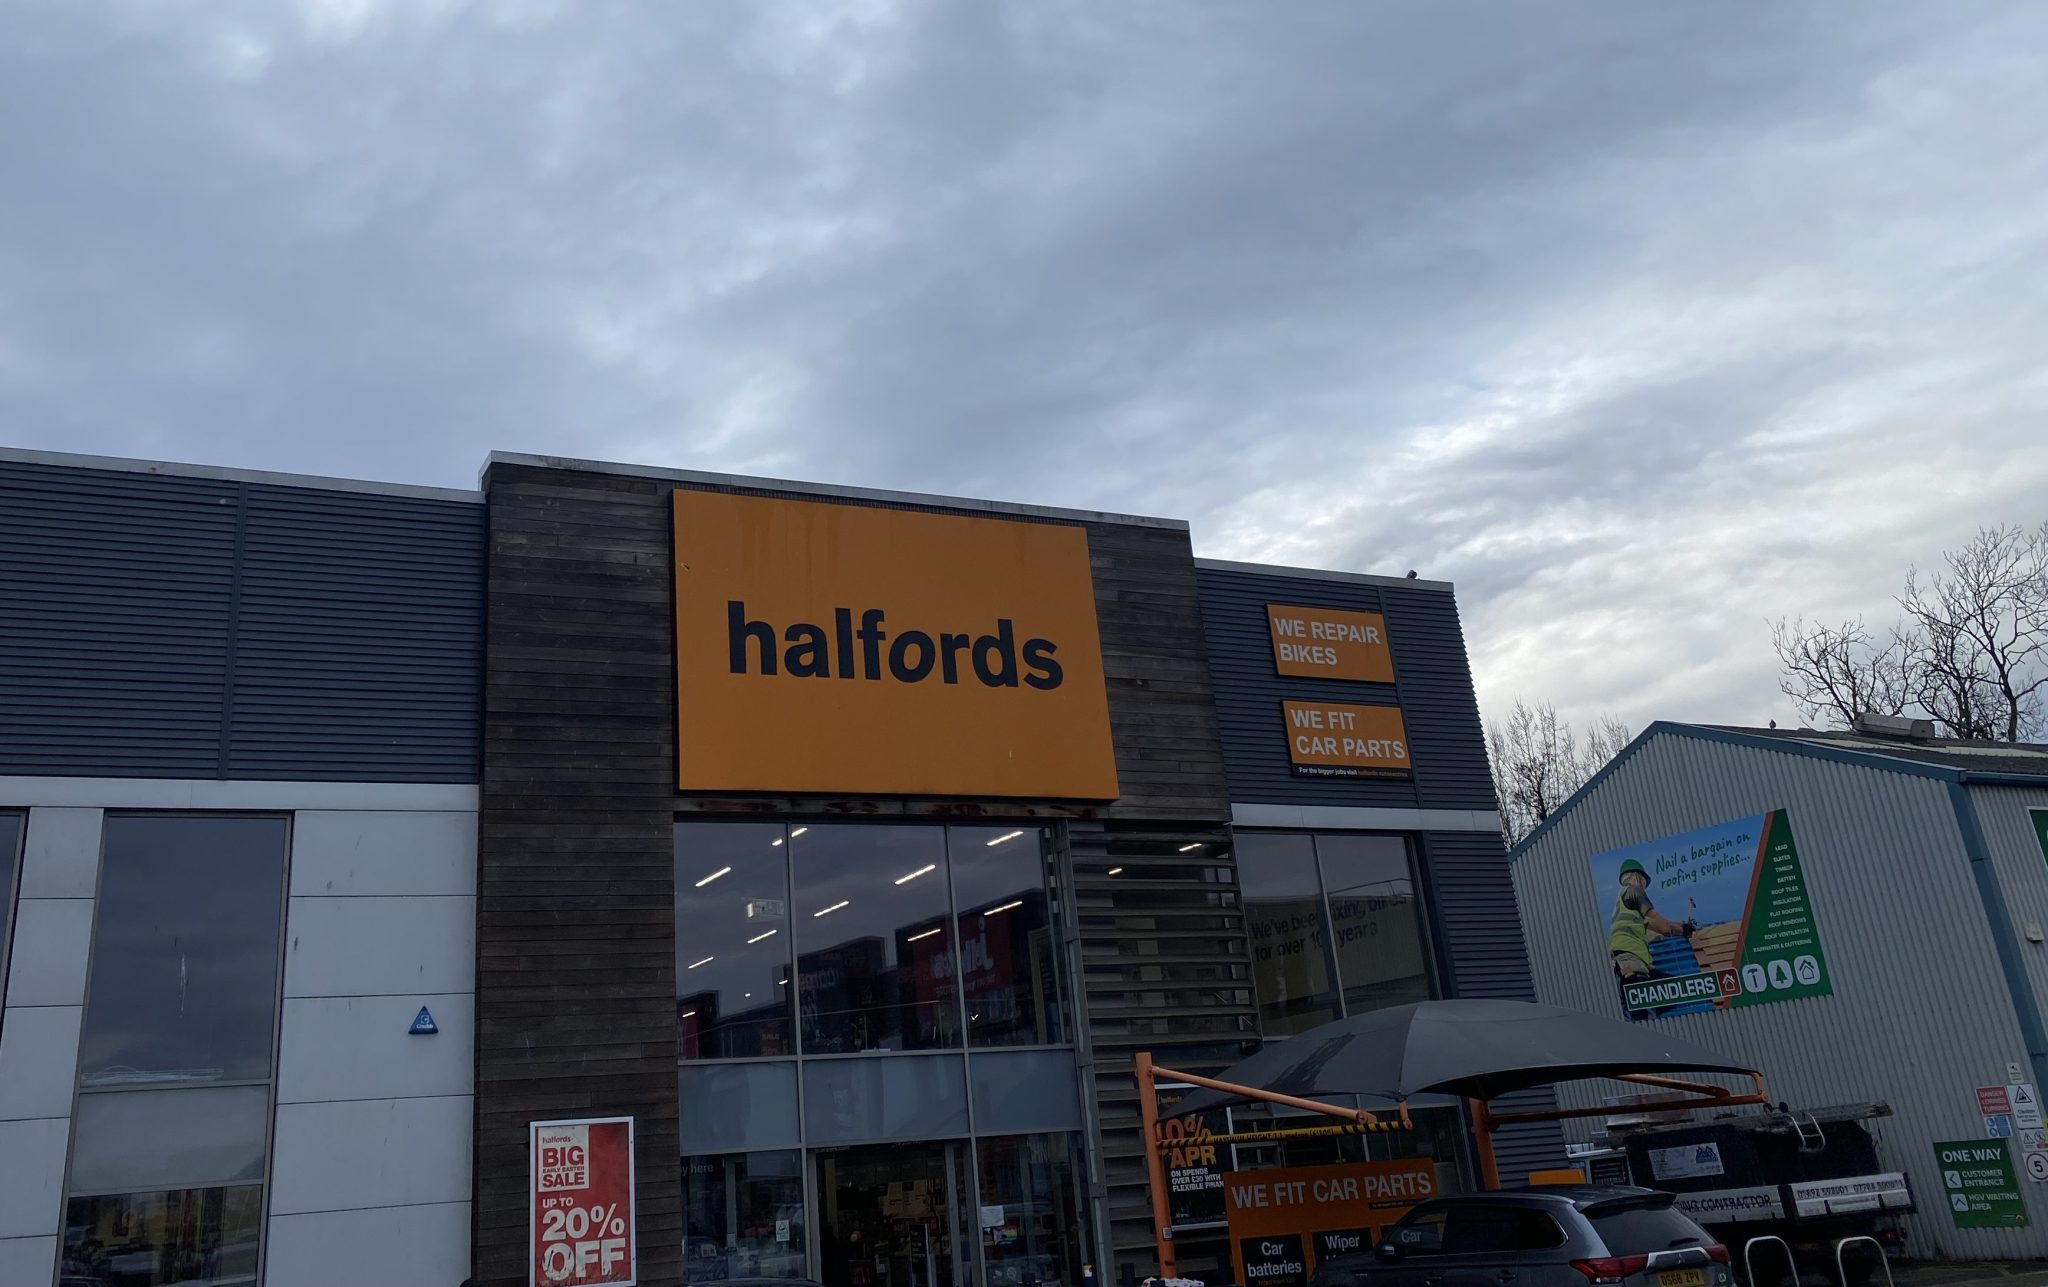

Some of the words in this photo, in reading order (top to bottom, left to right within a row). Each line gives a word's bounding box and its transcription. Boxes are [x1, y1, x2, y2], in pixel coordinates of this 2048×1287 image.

[1274, 617, 1307, 638] WE
[1311, 621, 1381, 644] REPAIR
[728, 600, 1063, 690] halfords
[1279, 643, 1338, 666] BIKES
[1291, 709, 1324, 728] WE
[1328, 711, 1356, 731] FIT
[1296, 735, 1339, 756] CAR
[1342, 738, 1406, 759] PARTS
[1318, 768, 1334, 776] bigger
[1656, 852, 1678, 875] Nail
[1681, 855, 1688, 864] a
[1691, 838, 1733, 859] bargain
[1736, 832, 1751, 843] on
[1660, 869, 1697, 889] roofing
[1627, 977, 1716, 1006] CHANDLERS
[542, 1135, 571, 1144] halfords
[542, 1145, 584, 1168] BIG
[1170, 1145, 1217, 1169] APR
[1942, 1149, 1971, 1163] ONE
[1971, 1148, 2001, 1161] WAY
[1171, 1169, 1181, 1178] ON
[1182, 1167, 1209, 1177] SPENDS
[1962, 1169, 2003, 1178] CUSTOMER
[2034, 1160, 2044, 1173] 5
[542, 1172, 585, 1188] SALE
[1172, 1176, 1190, 1185] OVER
[1204, 1173, 1221, 1182] WITH
[1172, 1182, 1204, 1193] FLEXIBLE
[1204, 1180, 1224, 1189] FINAN
[1963, 1178, 2005, 1187] ENTRANCE
[1231, 1184, 1269, 1209] WE
[1274, 1181, 1306, 1206] FIT
[1312, 1177, 1359, 1204] CAR
[1365, 1172, 1432, 1200] PARTS
[1968, 1193, 1985, 1201] HGV
[1985, 1192, 2019, 1201] WAITING
[542, 1199, 557, 1208] UP
[559, 1197, 574, 1206] TO
[1701, 1194, 1772, 1212] CONTRACTOR
[1971, 1202, 1992, 1211] AREA
[542, 1203, 625, 1242] 20%
[1324, 1233, 1360, 1252] Wiper
[1400, 1229, 1422, 1243] Car
[1261, 1241, 1284, 1257] Car
[541, 1238, 626, 1281] OFF
[1247, 1259, 1302, 1278] batteries
